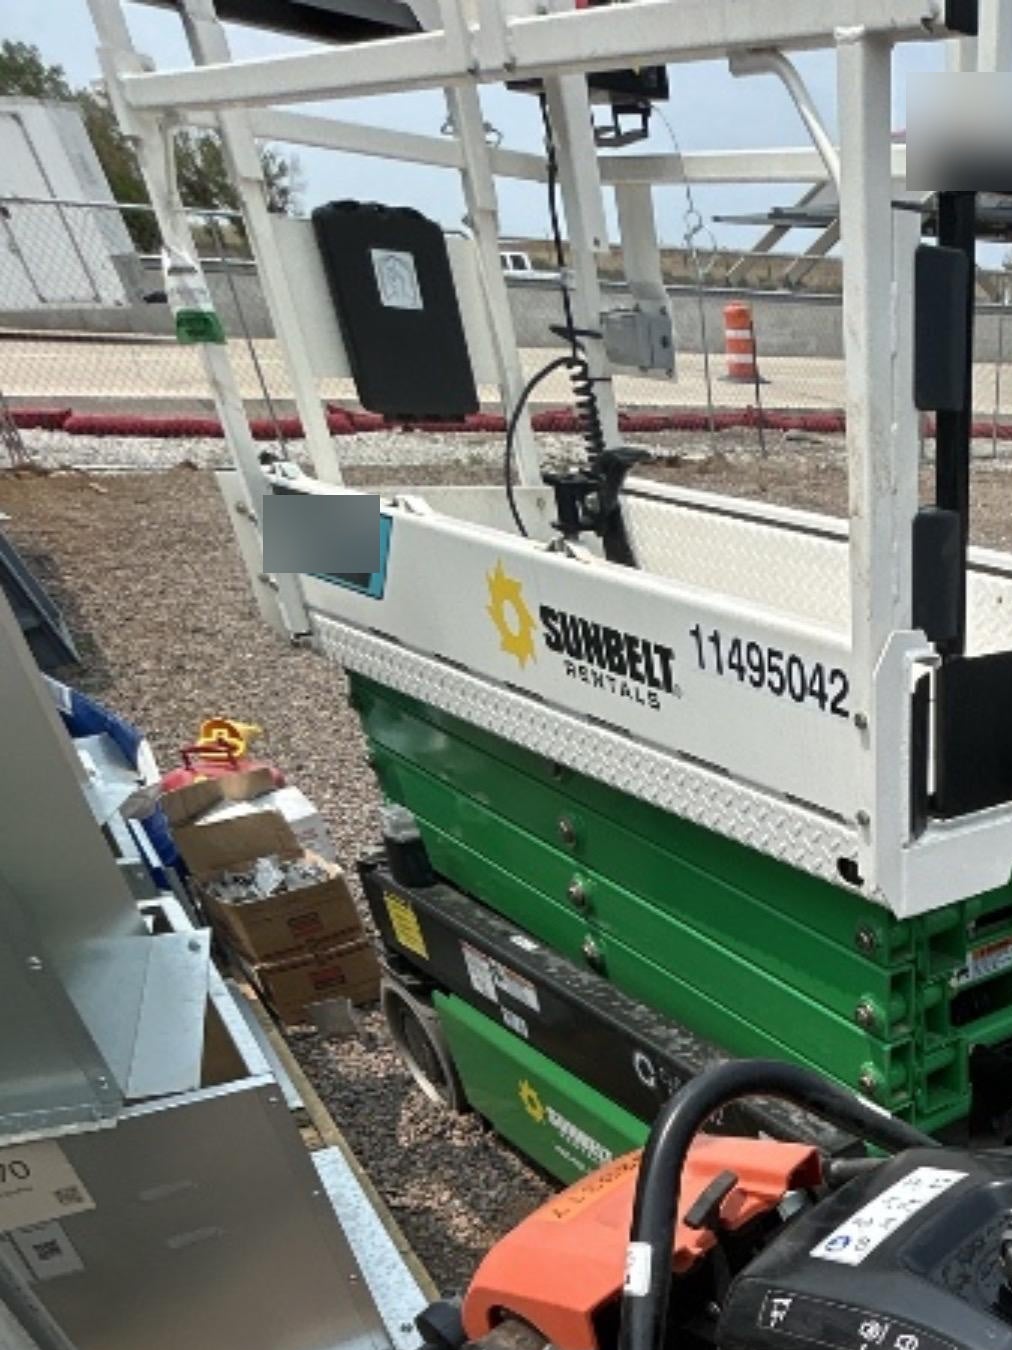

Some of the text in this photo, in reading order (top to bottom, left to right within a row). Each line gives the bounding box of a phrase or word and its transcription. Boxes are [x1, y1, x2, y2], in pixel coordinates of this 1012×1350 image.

[538, 603, 677, 693] SUNBELT
[562, 658, 662, 711] RENTALS
[688, 622, 850, 719] 11495042
